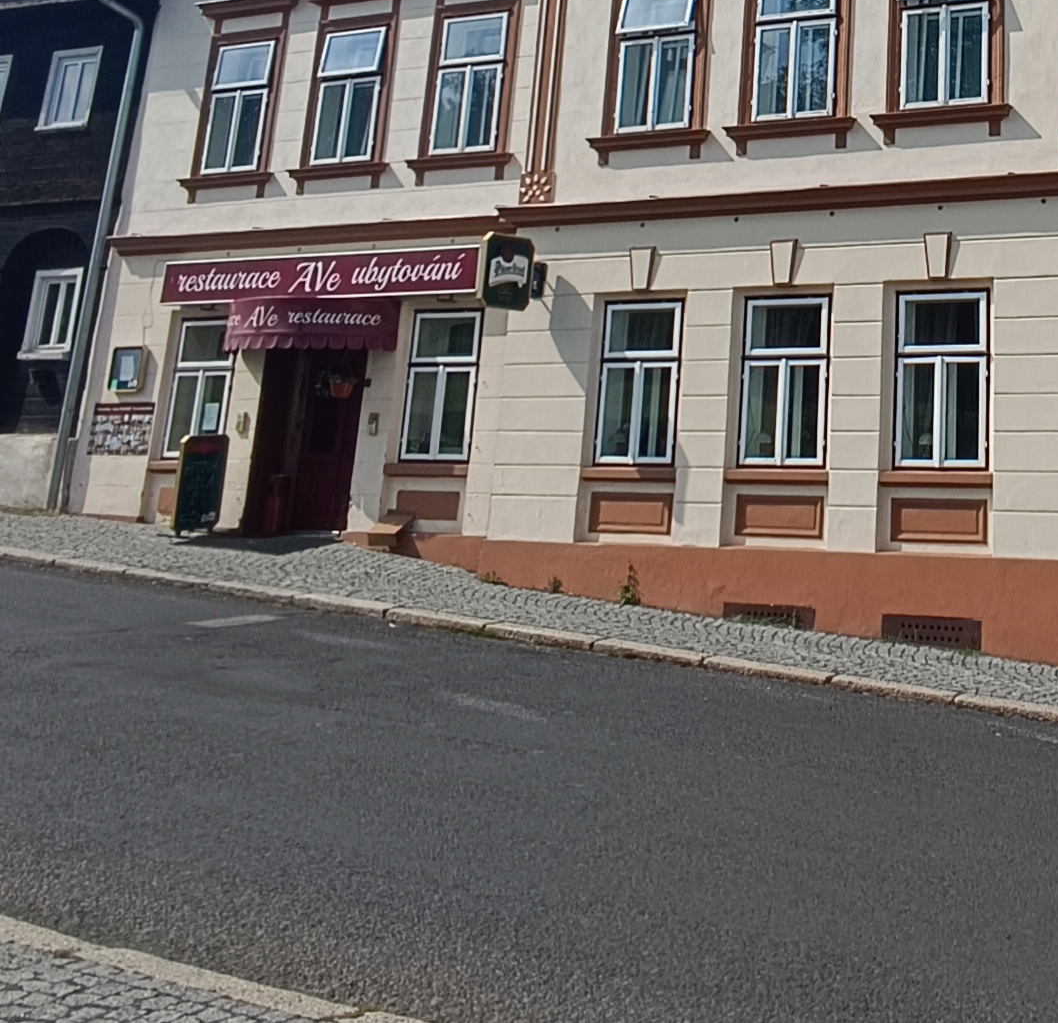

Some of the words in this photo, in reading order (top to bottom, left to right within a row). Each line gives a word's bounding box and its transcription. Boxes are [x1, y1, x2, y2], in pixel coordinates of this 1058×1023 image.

[178, 267, 281, 293] restaurace
[351, 253, 463, 291] ubytování
[288, 309, 382, 326] restaurace
